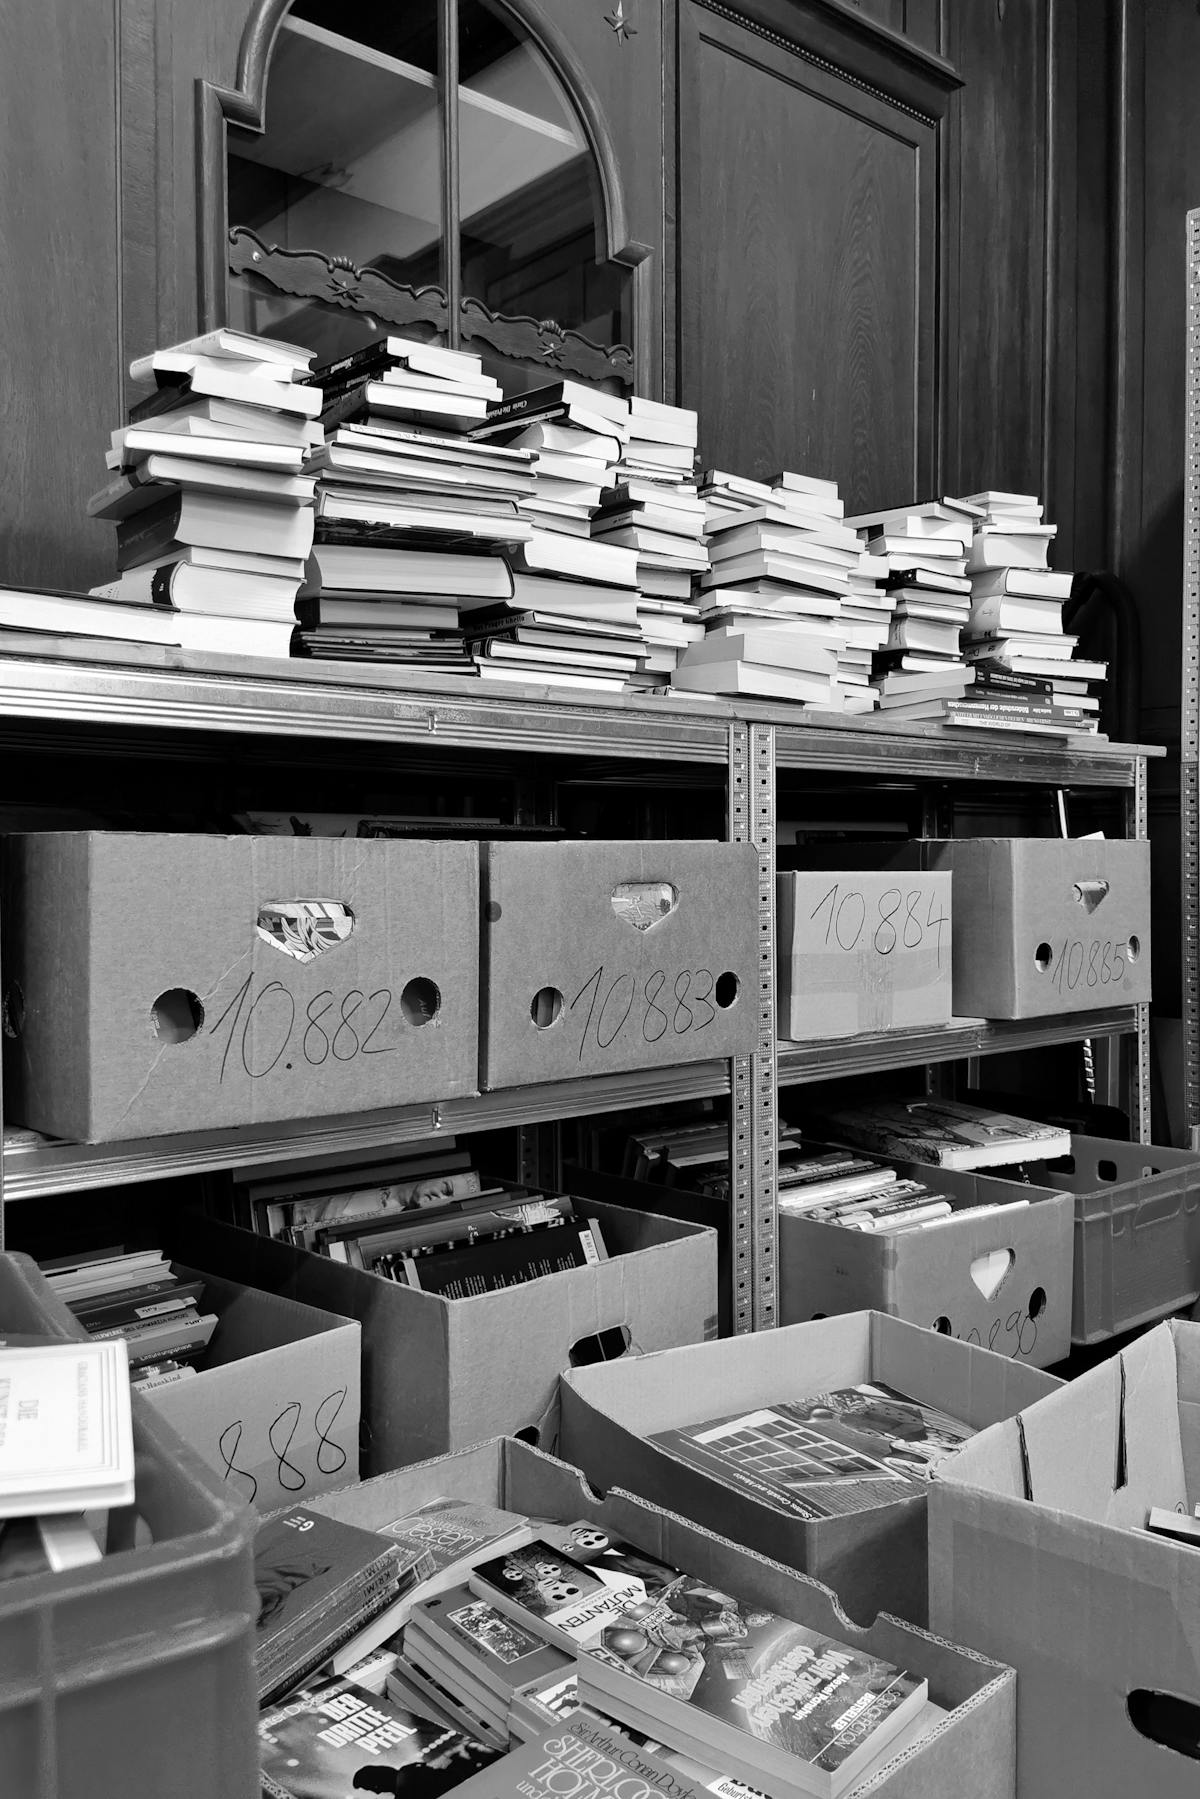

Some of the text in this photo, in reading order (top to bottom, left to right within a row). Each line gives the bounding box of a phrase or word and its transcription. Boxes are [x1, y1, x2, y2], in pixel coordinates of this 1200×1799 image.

[811, 883, 950, 970] 10.884
[1050, 938, 1131, 997] 10.885
[209, 971, 398, 1085] 10.882
[569, 967, 716, 1062] 10.883
[18, 1399, 39, 1421] DIE
[363, 1571, 392, 1598] KRIMI
[557, 1584, 643, 1632] MUTANTEN
[317, 1692, 369, 1722] DER
[791, 1687, 830, 1722] Panshin
[831, 1692, 877, 1732] BESTSELLER
[316, 1706, 393, 1749] DRITTE
[353, 1720, 419, 1756] PFEIL
[586, 1730, 622, 1756] Arthur
[618, 1750, 659, 1784] Conan
